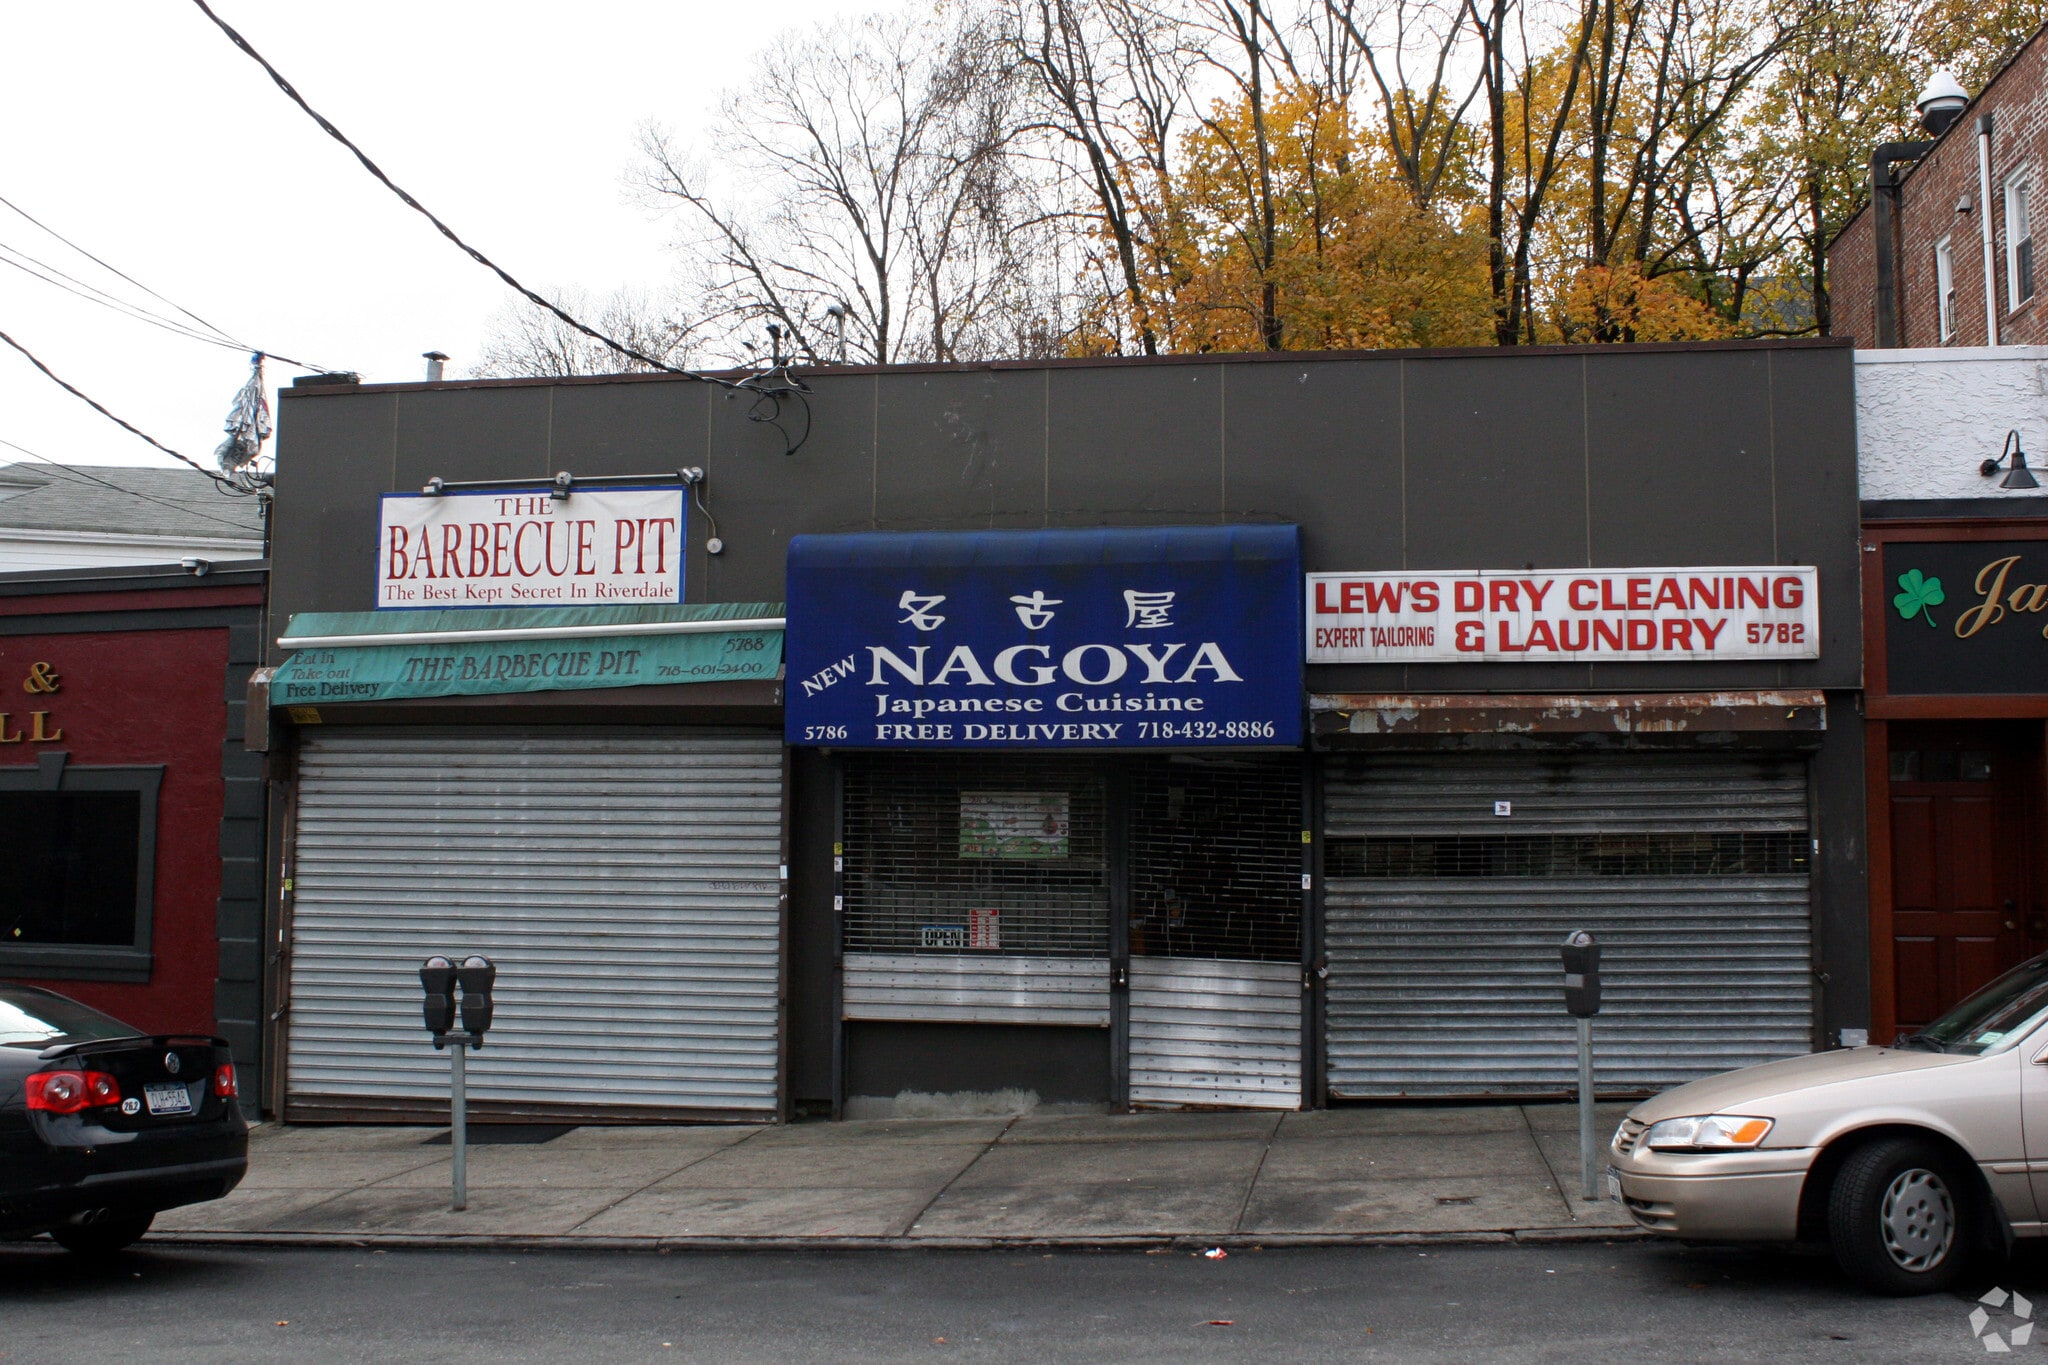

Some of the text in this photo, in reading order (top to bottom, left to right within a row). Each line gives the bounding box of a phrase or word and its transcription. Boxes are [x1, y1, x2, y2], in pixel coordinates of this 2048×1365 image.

[494, 496, 553, 516] THE
[386, 518, 675, 580] BARBECUE PIT
[384, 581, 673, 602] The Best Kept Secret In Riverdale
[1316, 576, 1804, 614] LEW'S DRY CLEANING
[1955, 555, 2048, 639] Ja
[898, 589, 1176, 631] 名古屋
[1316, 626, 1435, 648] EXPERT TAILORING
[1455, 618, 1728, 652] & LAUNDRY
[1747, 623, 1805, 644] 5782
[726, 637, 764, 654] 5788
[293, 651, 335, 665] Eat in
[406, 656, 456, 682] THE
[458, 651, 592, 681] BARBECUE
[865, 642, 1244, 686] NAGOYA
[23, 661, 60, 694] &
[291, 667, 351, 680] Take out
[657, 662, 762, 677] 718-601-2400
[801, 654, 855, 697] NEW
[286, 681, 380, 697] Free Delivery
[876, 692, 1204, 718] Japanese Cuisine
[804, 725, 848, 740] 5786
[876, 720, 1275, 740] FREE DELIVERY 718-432-8886
[925, 928, 960, 946] OPEN
